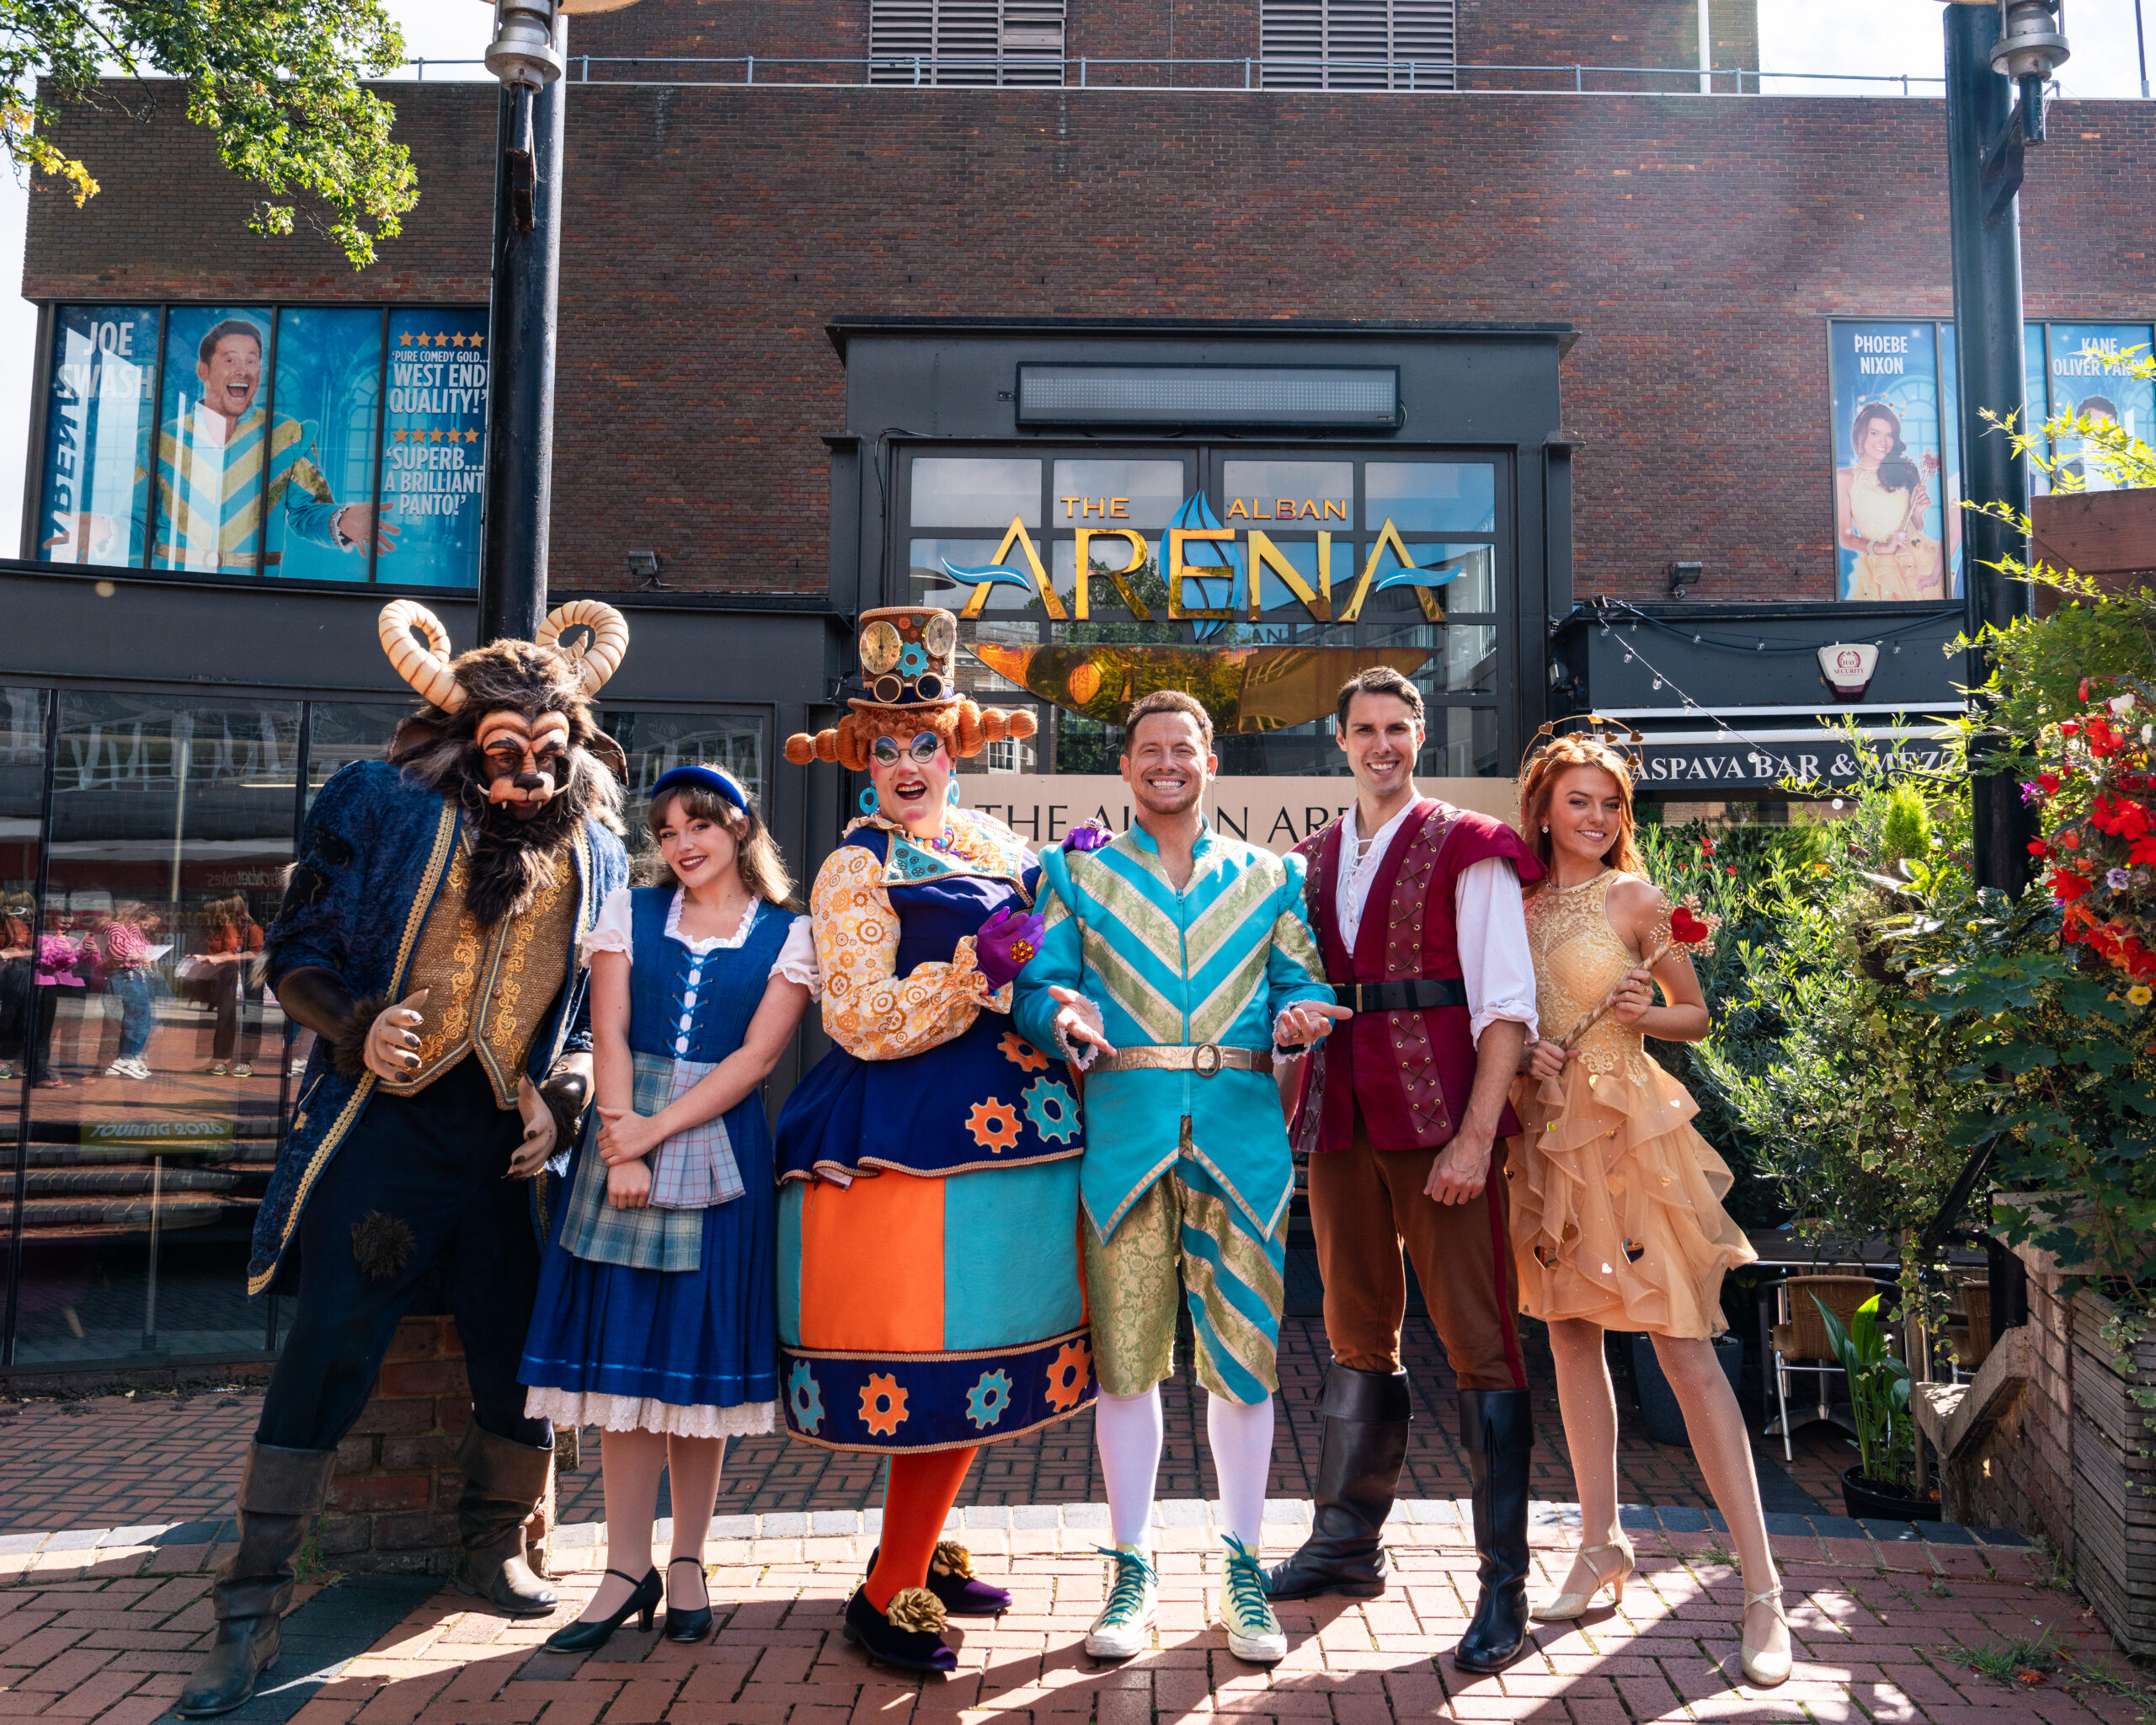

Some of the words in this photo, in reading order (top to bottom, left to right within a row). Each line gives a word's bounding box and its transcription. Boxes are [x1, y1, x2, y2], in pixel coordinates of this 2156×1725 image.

[83, 321, 135, 356] JOE
[1854, 334, 1908, 354] PHOEBE
[2081, 337, 2117, 355] KANE
[419, 350, 455, 363] COMEDY
[1860, 356, 1904, 375] NIXON
[2052, 358, 2101, 377] OLIVER
[56, 363, 155, 399] SWASH
[393, 363, 444, 387] WEST
[448, 364, 486, 387] END
[384, 473, 396, 493] A
[400, 472, 483, 494] BRILLIANT
[1059, 496, 1130, 519] THE
[1225, 498, 1348, 521] ALBAN
[958, 513, 1449, 622] ARENA
[1631, 756, 1746, 781] ASPAVA
[1753, 755, 1822, 778] BAR
[1830, 753, 1856, 777] &
[1866, 750, 1965, 776] MEZZ
[974, 804, 1069, 842] THE
[174, 1121, 225, 1135] 2026
